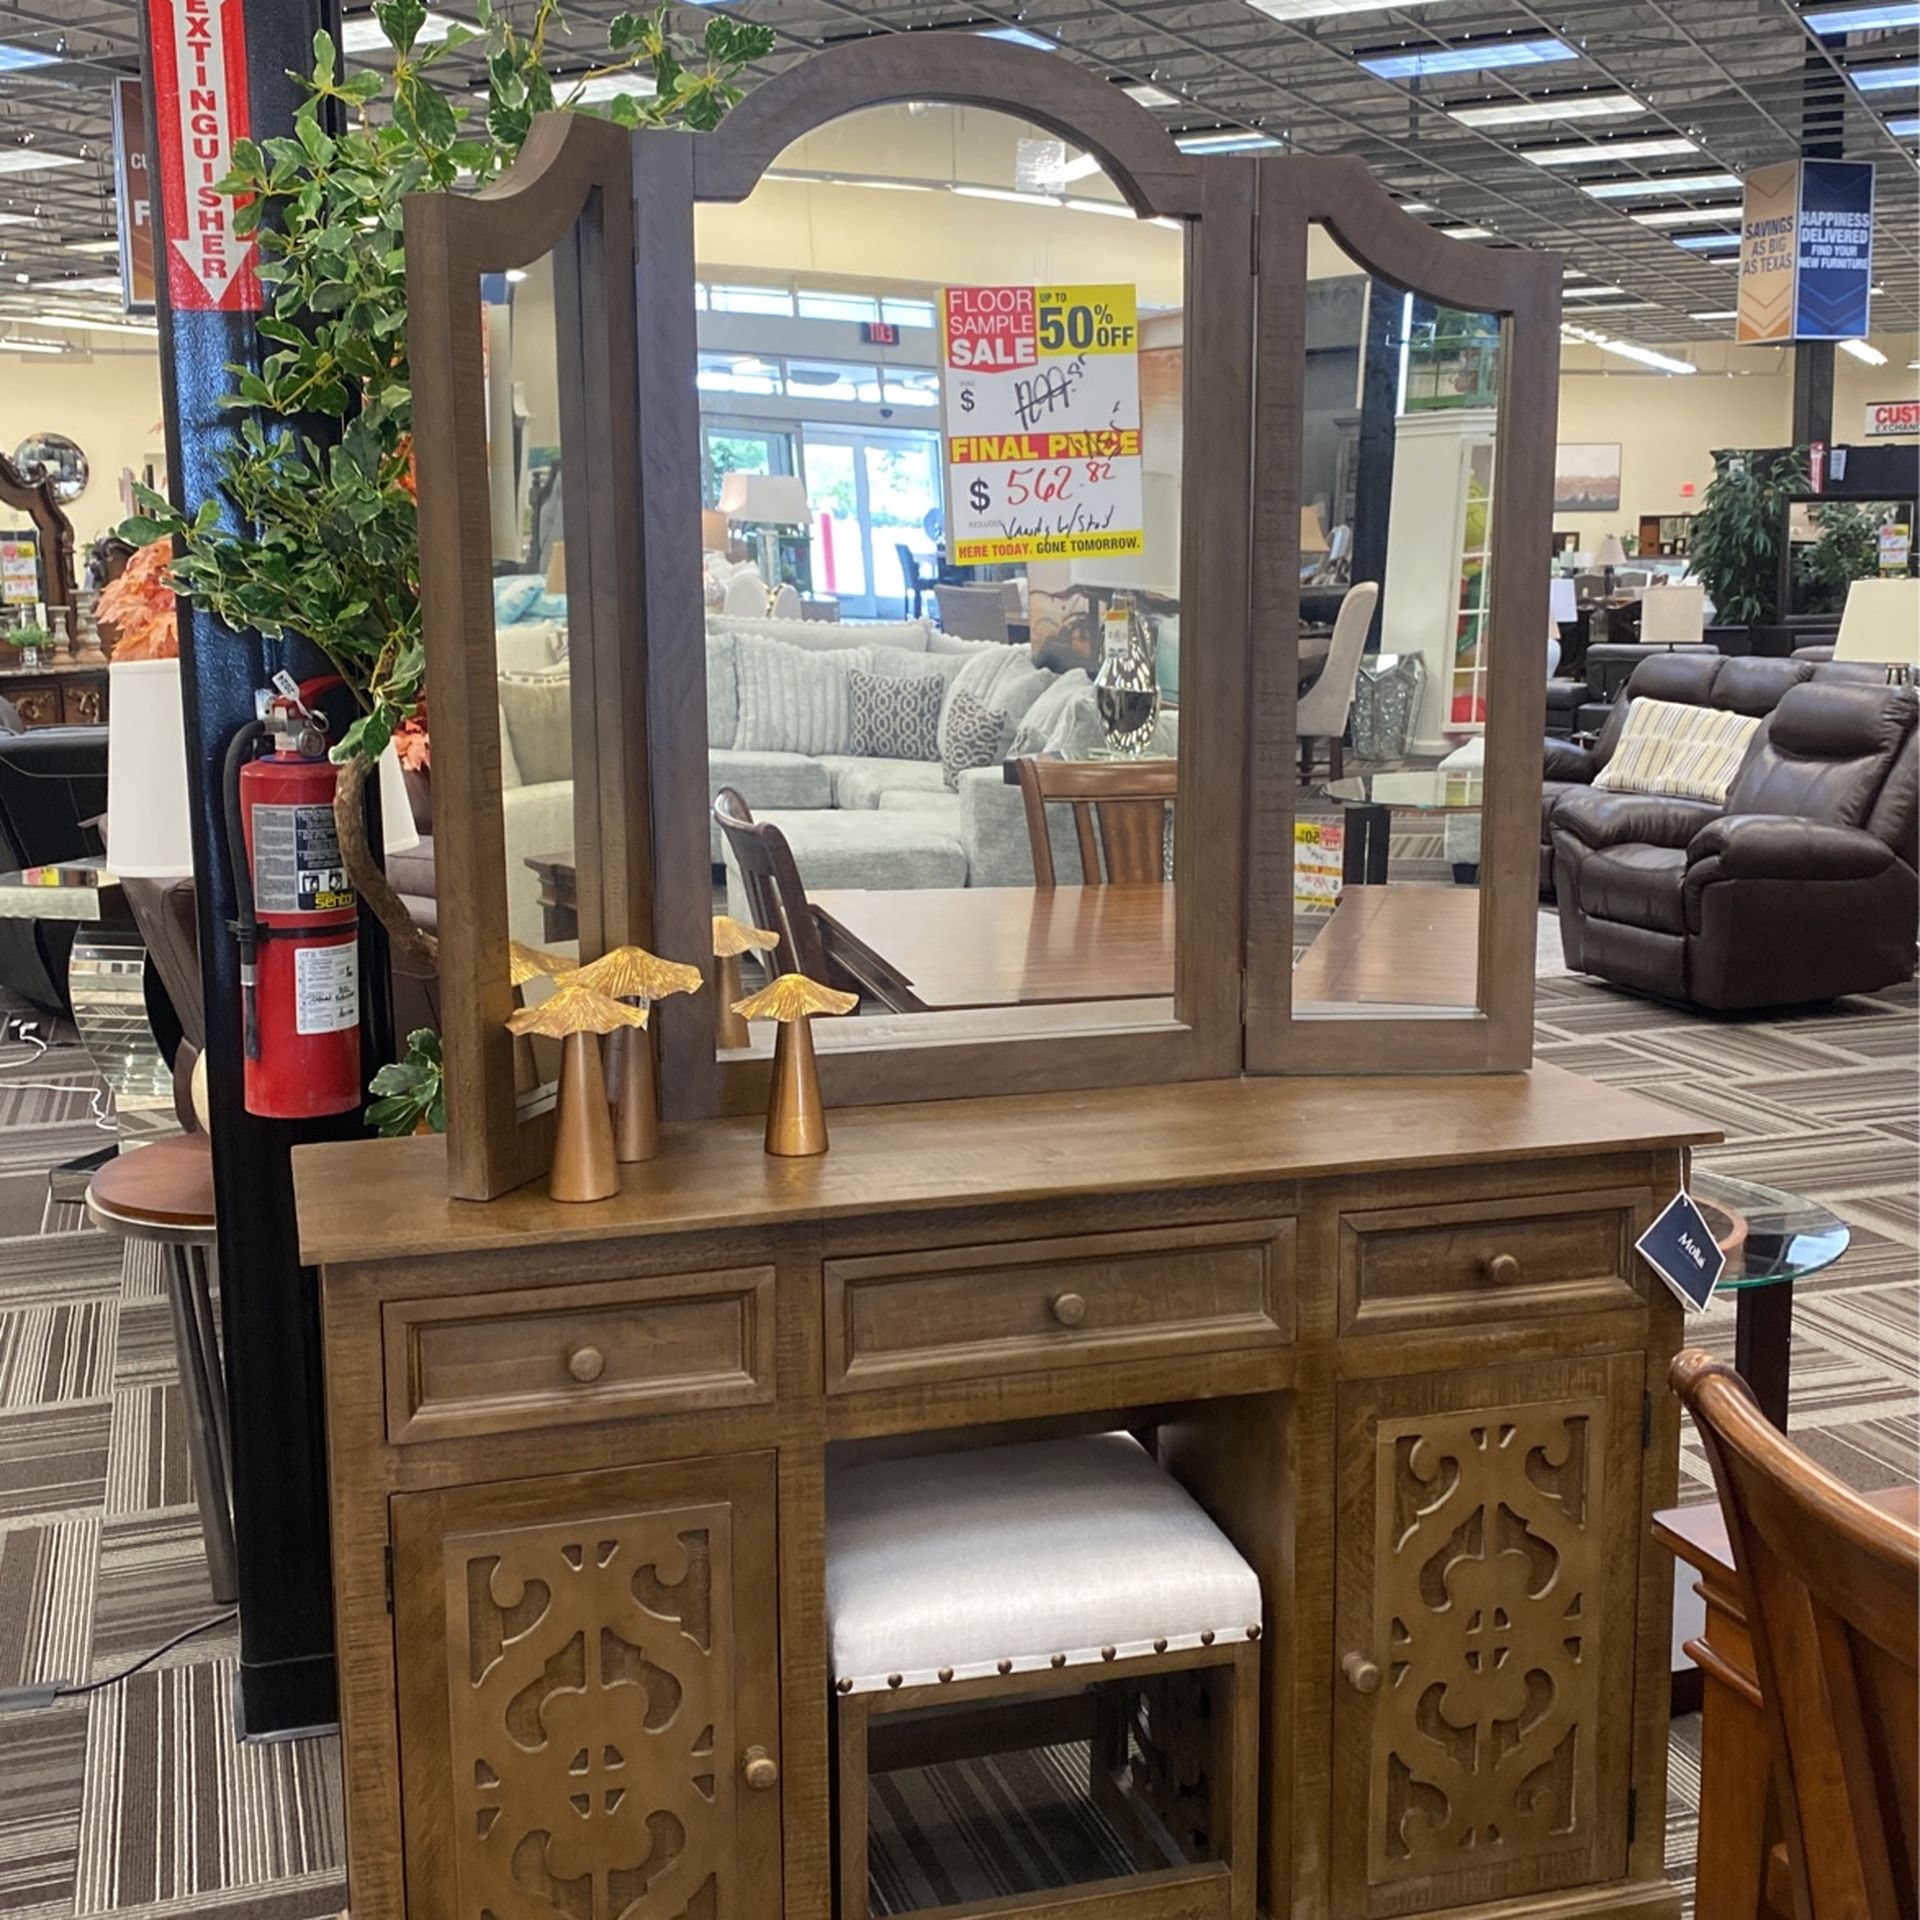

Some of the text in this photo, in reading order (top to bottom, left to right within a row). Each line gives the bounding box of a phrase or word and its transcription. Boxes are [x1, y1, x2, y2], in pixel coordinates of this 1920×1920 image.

[184, 0, 228, 279] EXTINGUISHER
[1745, 215, 1793, 240] SAVINGS
[1800, 211, 1870, 228] HAPPINESS
[1752, 236, 1786, 257] AS BIG
[1801, 228, 1868, 244] DELIVERED
[1811, 245, 1858, 257] FIND YOUR
[1743, 252, 1792, 275] AS TEXAS
[1799, 257, 1868, 270] NEW FURNITURE
[950, 290, 1032, 313] FLOOR
[1039, 292, 1067, 302] UP TO
[950, 315, 1033, 335] SAMPLE
[1096, 326, 1133, 347] OFF
[951, 337, 1036, 366] SALE
[960, 389, 975, 412] $
[952, 431, 1138, 462] FINAL PRICE
[969, 477, 990, 513] $
[959, 536, 1140, 559] HERE TODAY. GONE TOMORROW.
